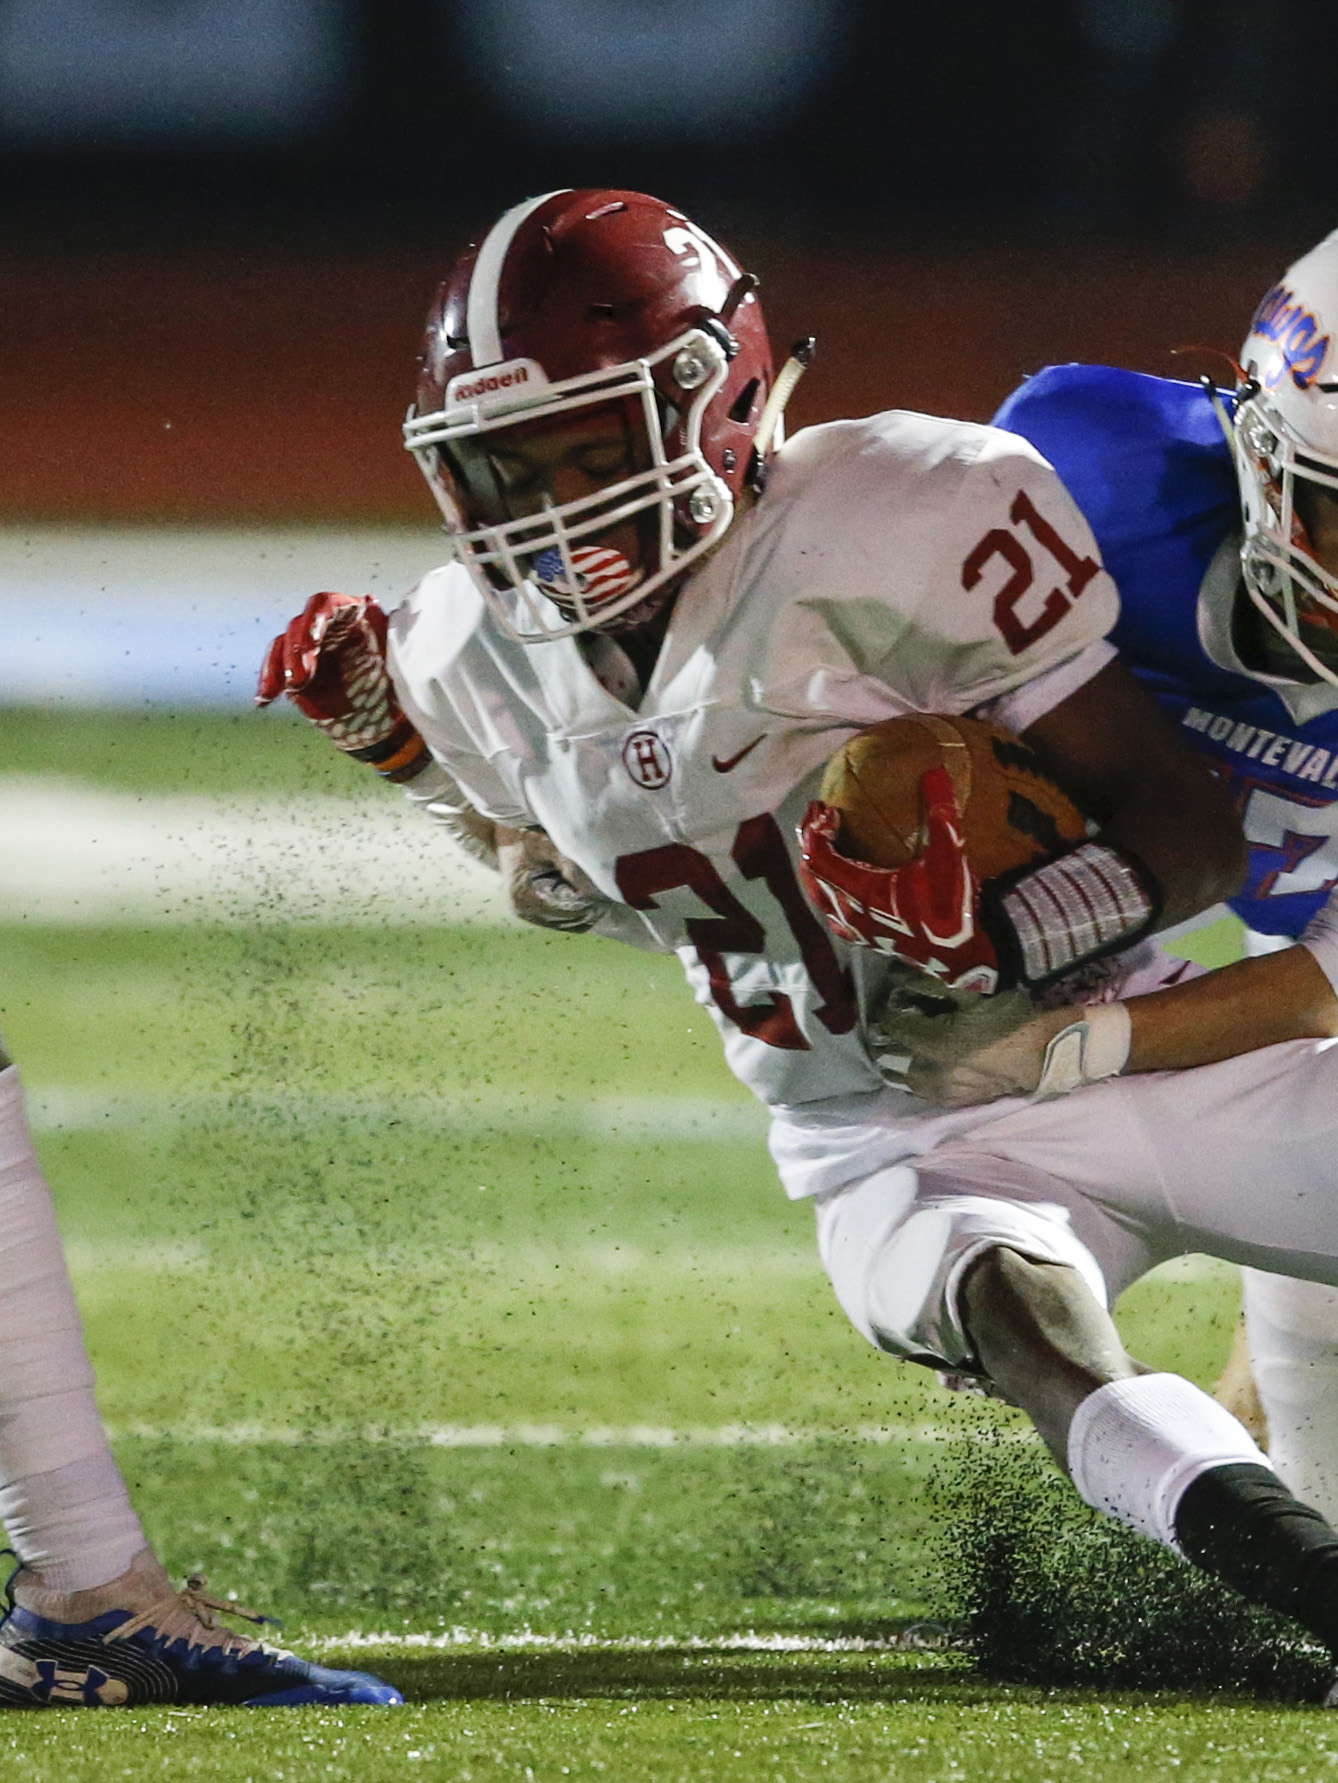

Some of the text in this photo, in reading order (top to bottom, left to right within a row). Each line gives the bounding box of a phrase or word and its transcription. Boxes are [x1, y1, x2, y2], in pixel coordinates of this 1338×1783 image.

[962, 489, 1101, 655] 21
[631, 739, 664, 783] H
[614, 812, 858, 1051] 21
